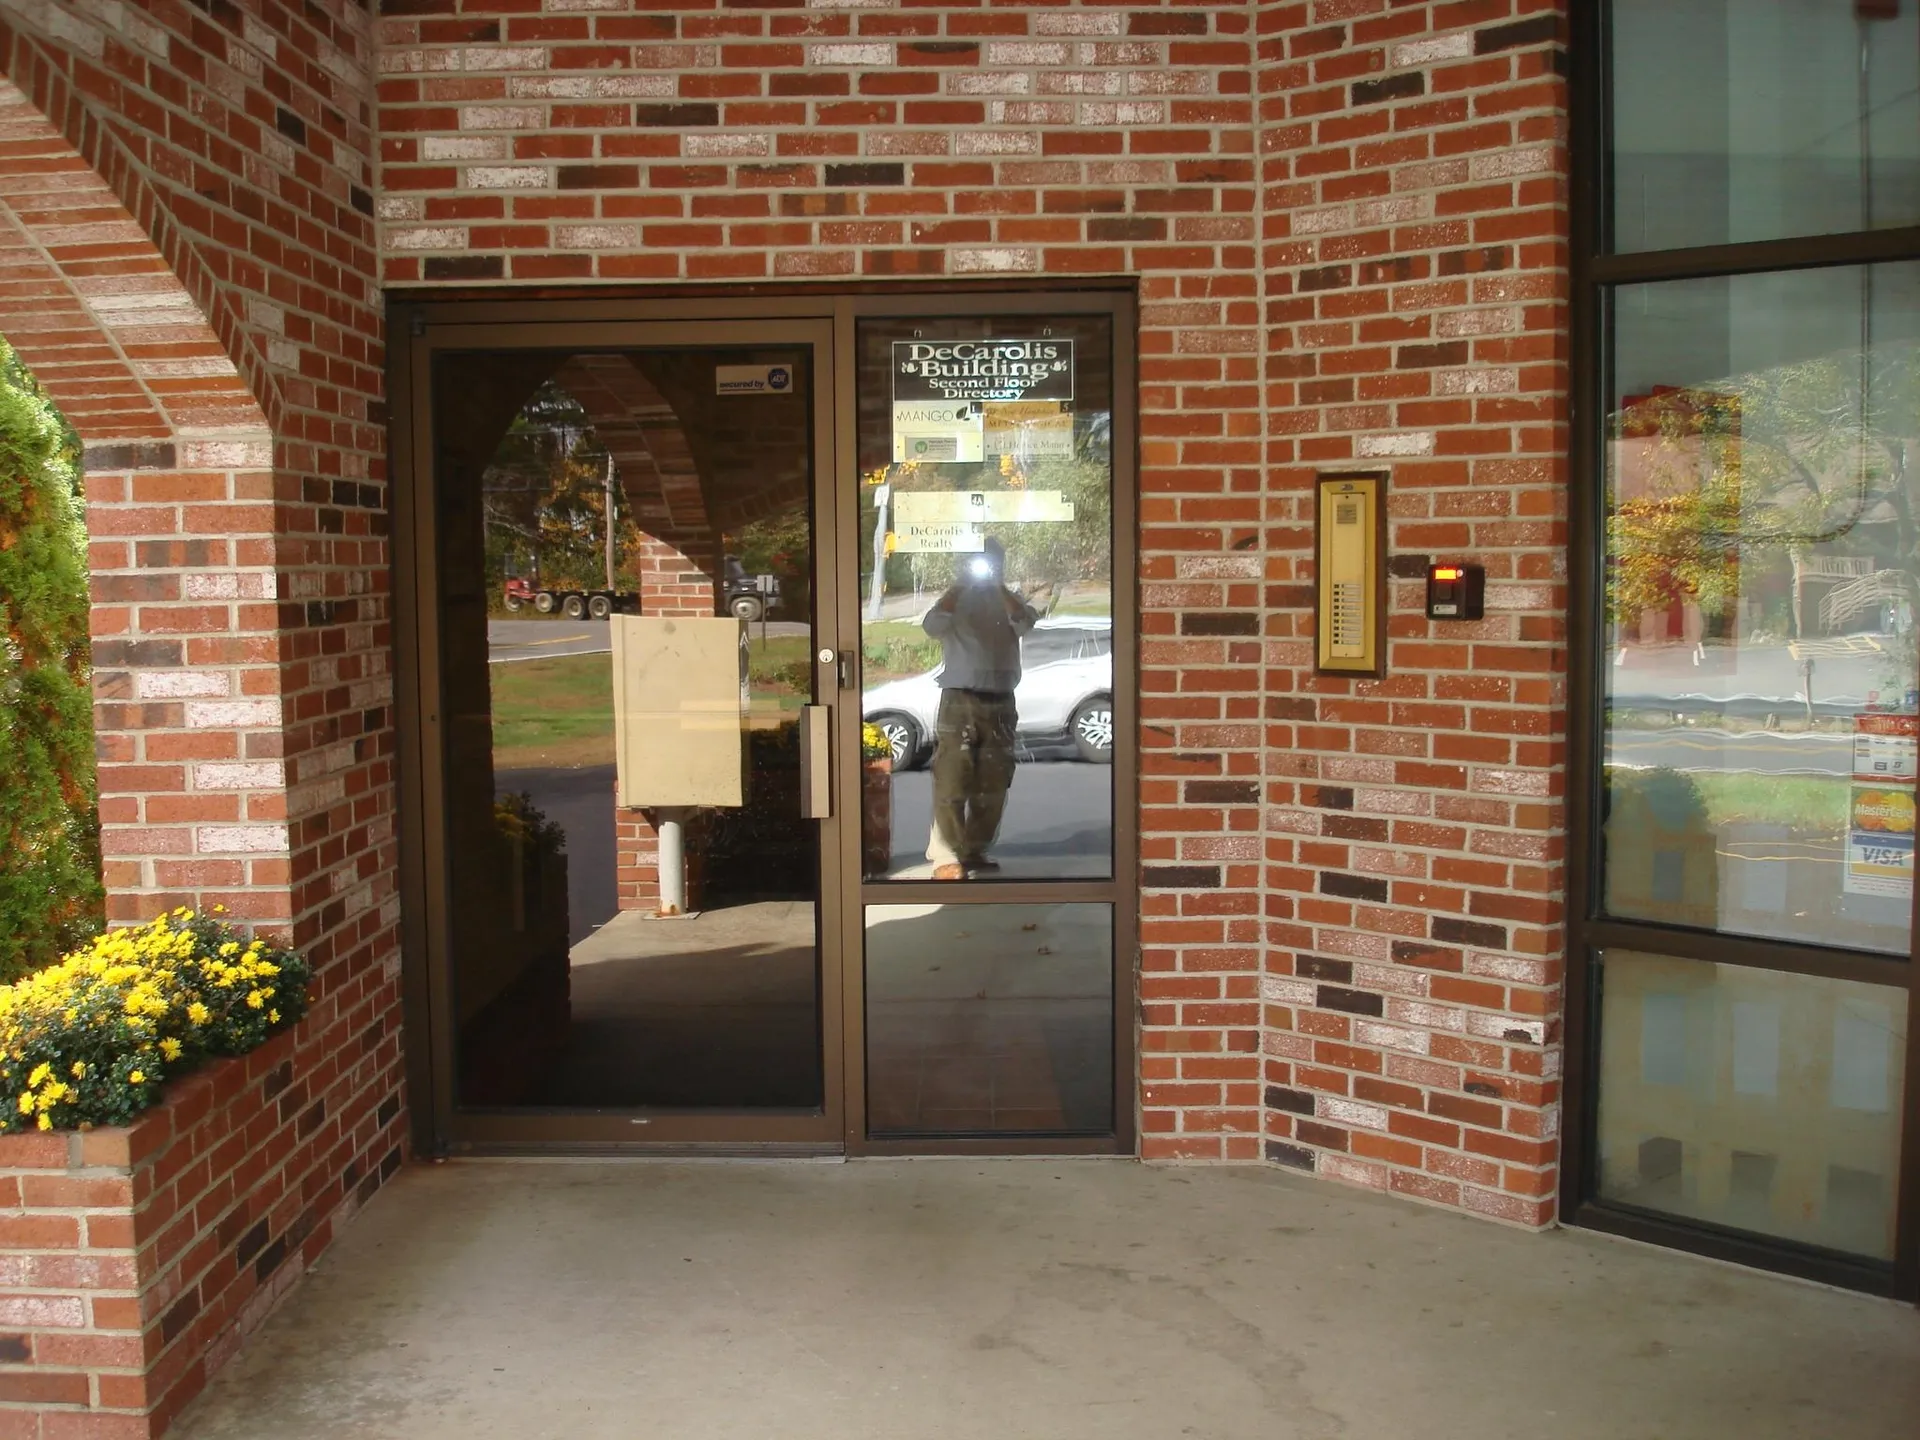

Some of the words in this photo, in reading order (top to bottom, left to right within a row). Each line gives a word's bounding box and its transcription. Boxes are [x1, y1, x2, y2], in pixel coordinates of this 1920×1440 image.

[909, 343, 1058, 361] DeCarolis
[919, 360, 1049, 380] Building
[928, 378, 989, 388] Second
[994, 376, 1039, 388] Floor
[943, 388, 1025, 399] Directory
[899, 410, 953, 422] MANGO
[910, 526, 964, 536] DeCarolis
[920, 539, 952, 550] Realty
[1854, 803, 1914, 818] MasterCard
[1862, 847, 1904, 867] VISA
